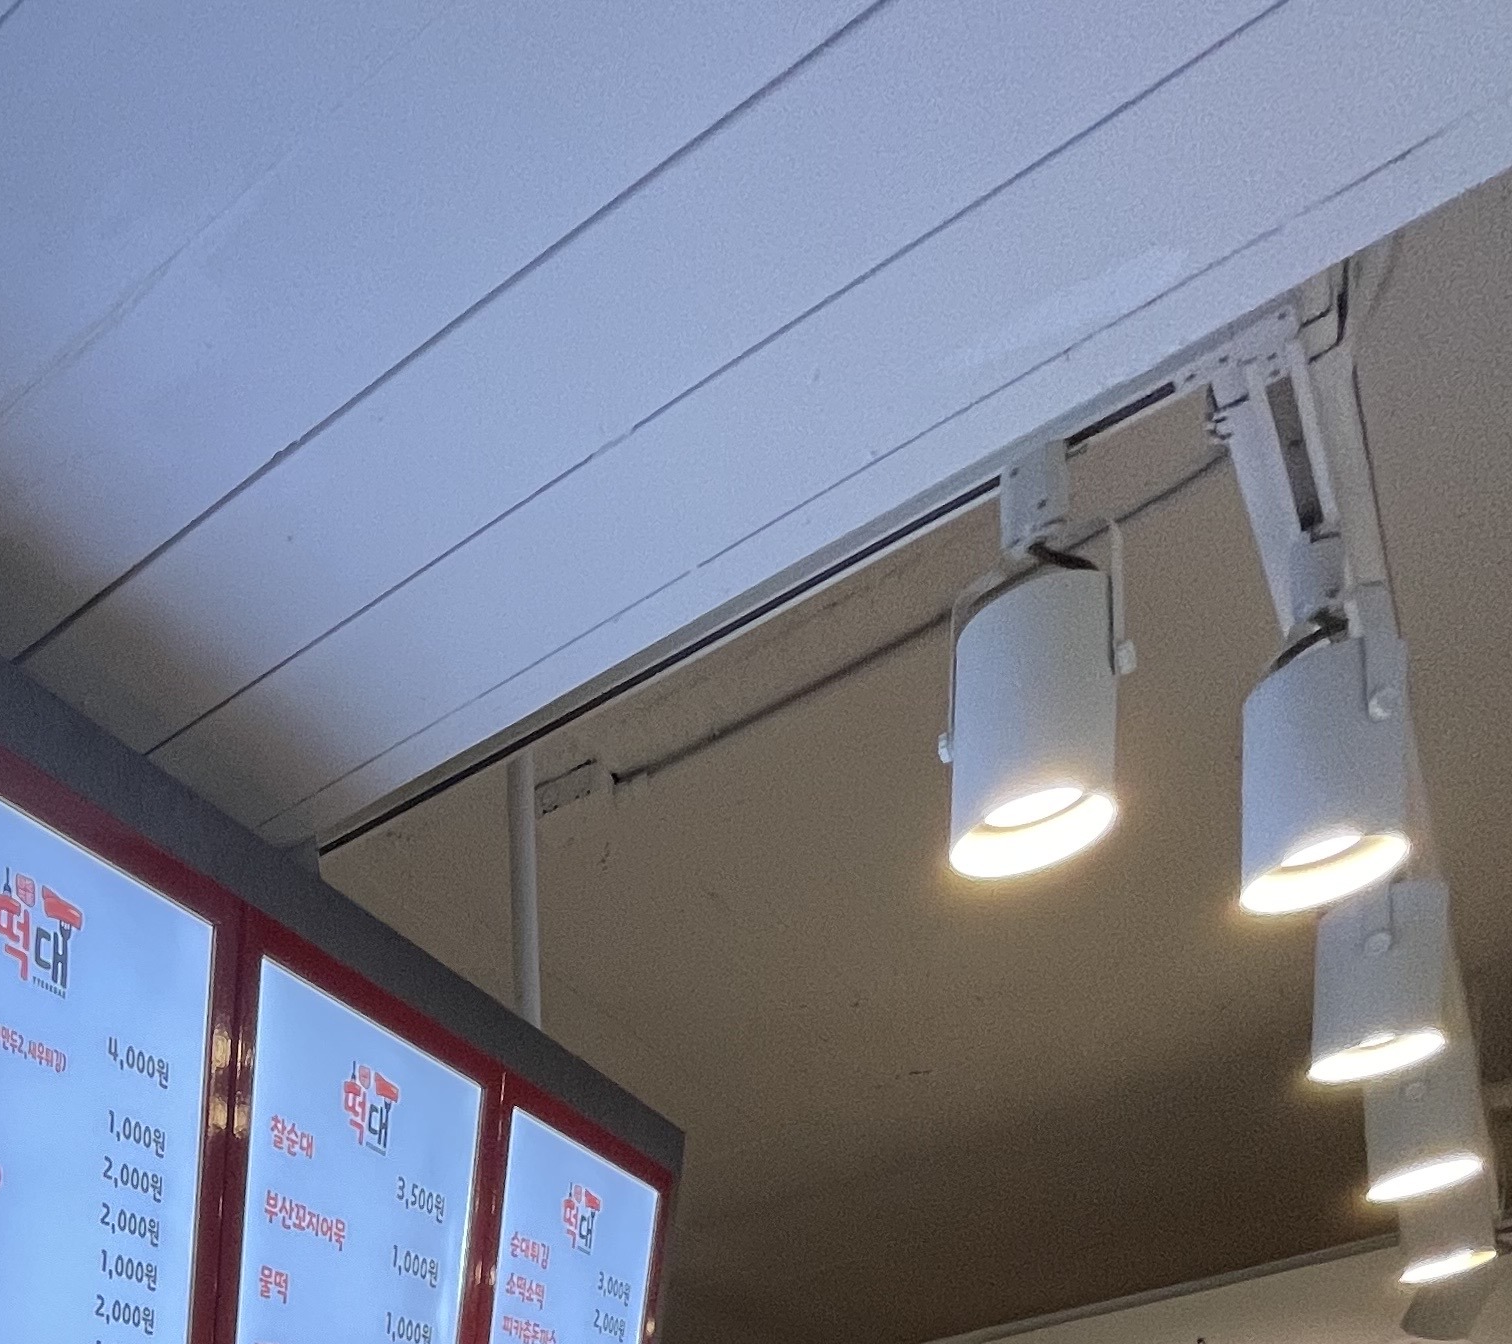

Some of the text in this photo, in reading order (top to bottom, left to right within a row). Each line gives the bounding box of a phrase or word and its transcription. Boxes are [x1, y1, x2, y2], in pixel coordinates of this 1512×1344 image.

[107, 1037, 170, 1090] 4,000원
[107, 1110, 166, 1158] 1,000원
[269, 1114, 314, 1160] 찰순대
[102, 1157, 164, 1203] 2,000원
[397, 1177, 446, 1224] 3,500원
[100, 1203, 160, 1247] 2,000원
[100, 1248, 158, 1290] 1,000원
[259, 1266, 288, 1304] 물떡
[393, 1245, 439, 1288] 1,000원
[597, 1271, 631, 1307] 3,000원
[95, 1294, 155, 1335] 2,000원
[593, 1309, 626, 1342] 2,000원
